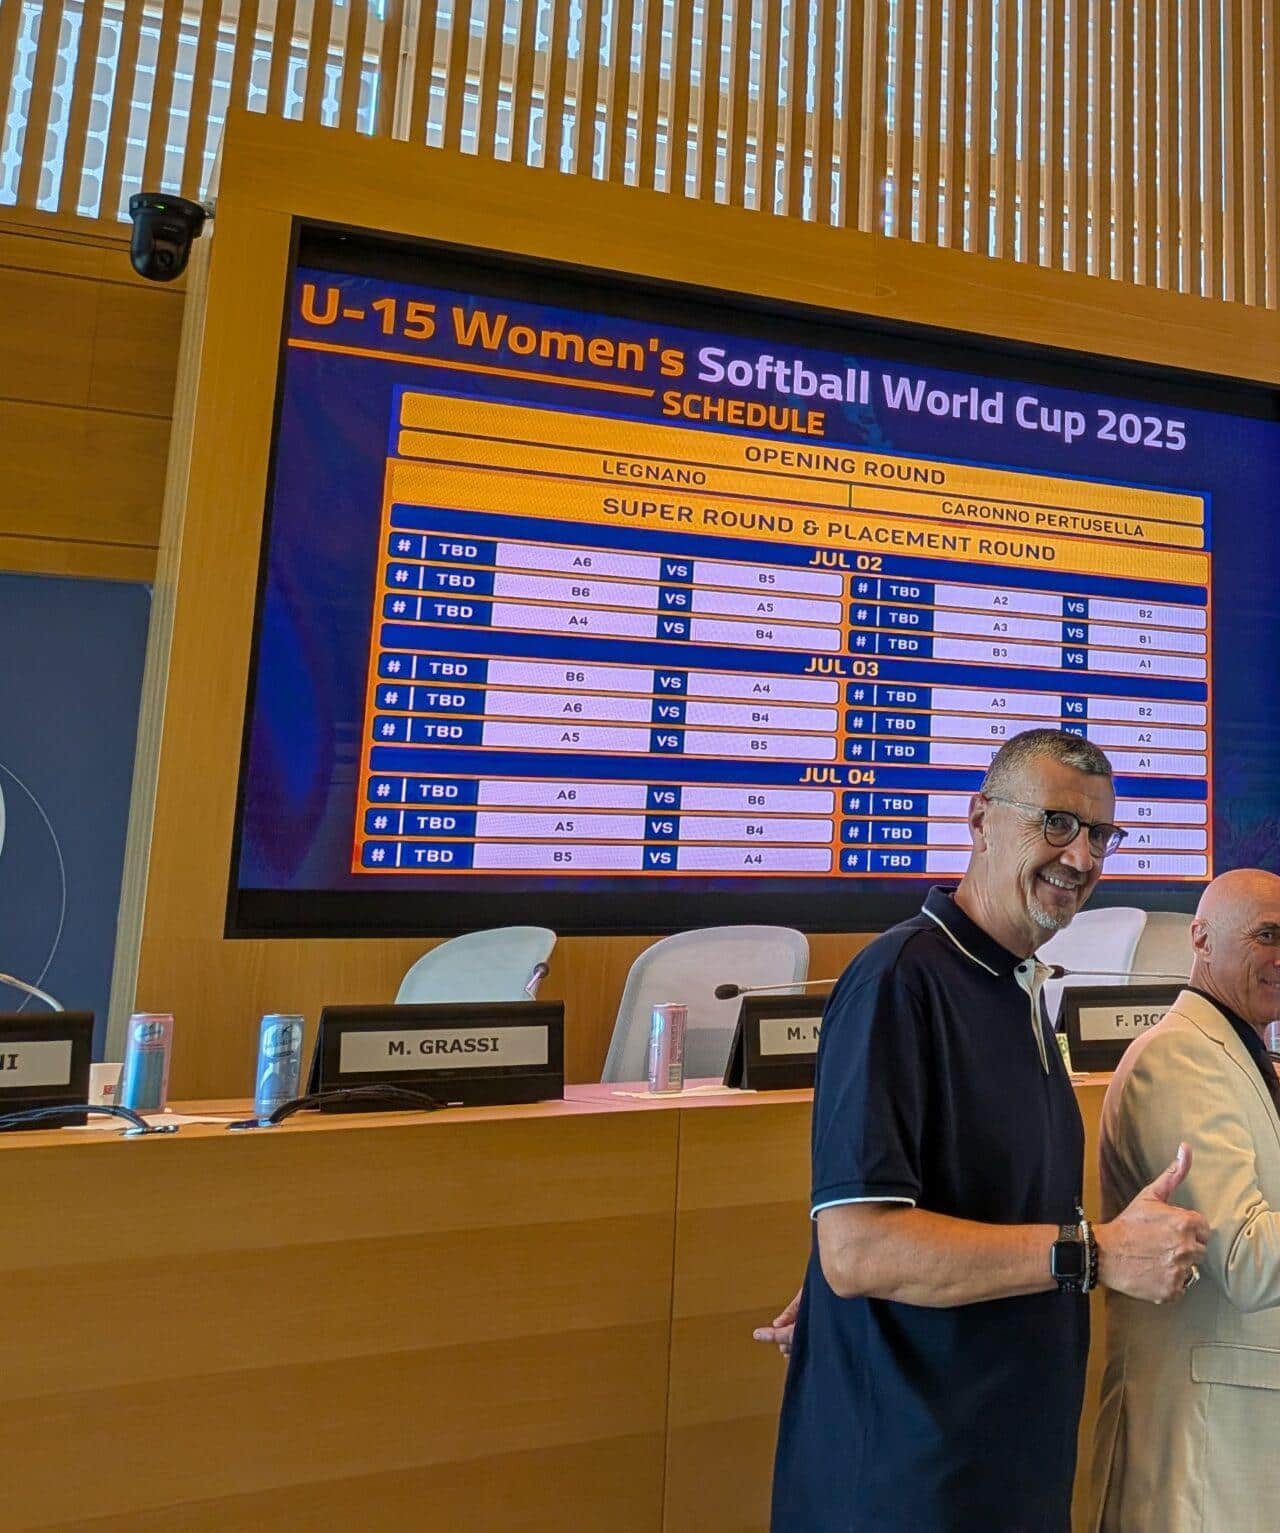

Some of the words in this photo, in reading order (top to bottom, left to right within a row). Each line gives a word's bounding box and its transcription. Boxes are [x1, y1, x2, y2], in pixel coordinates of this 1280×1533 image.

[301, 284, 435, 339] U-15
[453, 308, 684, 376] Women's
[699, 347, 869, 404] Softball
[883, 375, 1003, 424] World
[1016, 397, 1085, 443] Cup
[1098, 410, 1185, 450] 2025
[663, 391, 824, 435] SCHEDULE
[603, 461, 705, 484] LEGNANO
[746, 447, 854, 473] OPENING
[865, 462, 944, 484] ROUND
[604, 499, 693, 522] SUPER
[704, 509, 792, 532] ROUND
[803, 520, 819, 535] &
[829, 523, 970, 551] PLACEMENT
[980, 540, 1054, 560] ROUND
[943, 502, 1029, 523] CARONNO
[1036, 513, 1143, 536] PERTUSELLA
[397, 539, 411, 552] #
[438, 543, 478, 558] TBD
[572, 557, 592, 567] A6
[666, 564, 688, 577] VS
[758, 573, 776, 584] B5
[809, 552, 850, 569] JUL
[856, 556, 882, 573] 02
[395, 569, 409, 582] #
[436, 573, 476, 588] TBD
[571, 586, 590, 597] B6
[664, 593, 686, 606] VS
[756, 602, 774, 613] A5
[858, 582, 868, 593] #
[889, 585, 920, 598] TBD
[993, 596, 1009, 606] A2
[1067, 601, 1085, 613] VS
[1139, 609, 1153, 619] B2
[392, 600, 407, 613] #
[434, 604, 473, 618] TBD
[568, 615, 589, 626] A4
[663, 621, 685, 634] VS
[755, 629, 773, 640] B4
[857, 609, 868, 621] #
[888, 612, 919, 625] TBD
[993, 622, 1008, 632] A3
[1066, 627, 1084, 639] VS
[1139, 635, 1152, 644] B1
[856, 635, 867, 647] #
[888, 638, 919, 651] TBD
[992, 647, 1008, 658] B3
[1066, 653, 1084, 664] VS
[1139, 659, 1151, 669] A1
[387, 660, 401, 673] #
[429, 662, 468, 676] TBD
[565, 671, 585, 682] B6
[660, 676, 682, 689] VS
[752, 683, 771, 694] A4
[804, 657, 847, 674] JUL
[852, 661, 879, 677] 03
[384, 691, 399, 705] #
[426, 693, 466, 707] TBD
[562, 702, 583, 713] A6
[658, 705, 680, 718] VS
[751, 712, 769, 723] B4
[853, 689, 865, 701] #
[886, 690, 917, 703] TBD
[990, 698, 1006, 708] A3
[1065, 701, 1083, 713] VS
[1138, 707, 1152, 717] B2
[381, 723, 396, 736] #
[424, 725, 463, 739] TBD
[560, 732, 580, 743] A5
[656, 735, 679, 747] VS
[750, 740, 768, 751] B5
[853, 716, 864, 729] #
[885, 718, 916, 730] TBD
[990, 725, 1006, 735] B3
[1137, 733, 1152, 743] A2
[851, 744, 863, 756] #
[884, 745, 915, 757] TBD
[1138, 758, 1151, 768] A1
[799, 768, 842, 785] JUL
[847, 769, 876, 785] 04
[376, 783, 391, 797] #
[419, 784, 458, 798] TBD
[556, 790, 577, 800] A6
[653, 791, 675, 804] VS
[747, 795, 765, 806] B6
[849, 798, 860, 810] #
[882, 798, 913, 810] TBD
[1137, 807, 1152, 817] B3
[373, 815, 388, 829] #
[416, 816, 456, 830] TBD
[554, 821, 574, 832] A5
[651, 821, 673, 834] VS
[746, 825, 764, 836] B4
[848, 826, 859, 838] #
[881, 827, 913, 839] TBD
[1138, 834, 1151, 844] A1
[371, 848, 386, 862] #
[414, 849, 454, 863] TBD
[553, 851, 572, 863] B5
[649, 852, 671, 864] VS
[744, 854, 762, 865] A4
[847, 854, 859, 866] #
[880, 855, 912, 867] TBD
[1137, 859, 1151, 869] B1
[1115, 1014, 1129, 1027] F.
[787, 1027, 807, 1041] M.
[389, 1041, 410, 1055] M.
[420, 1038, 498, 1054] GRASSI
